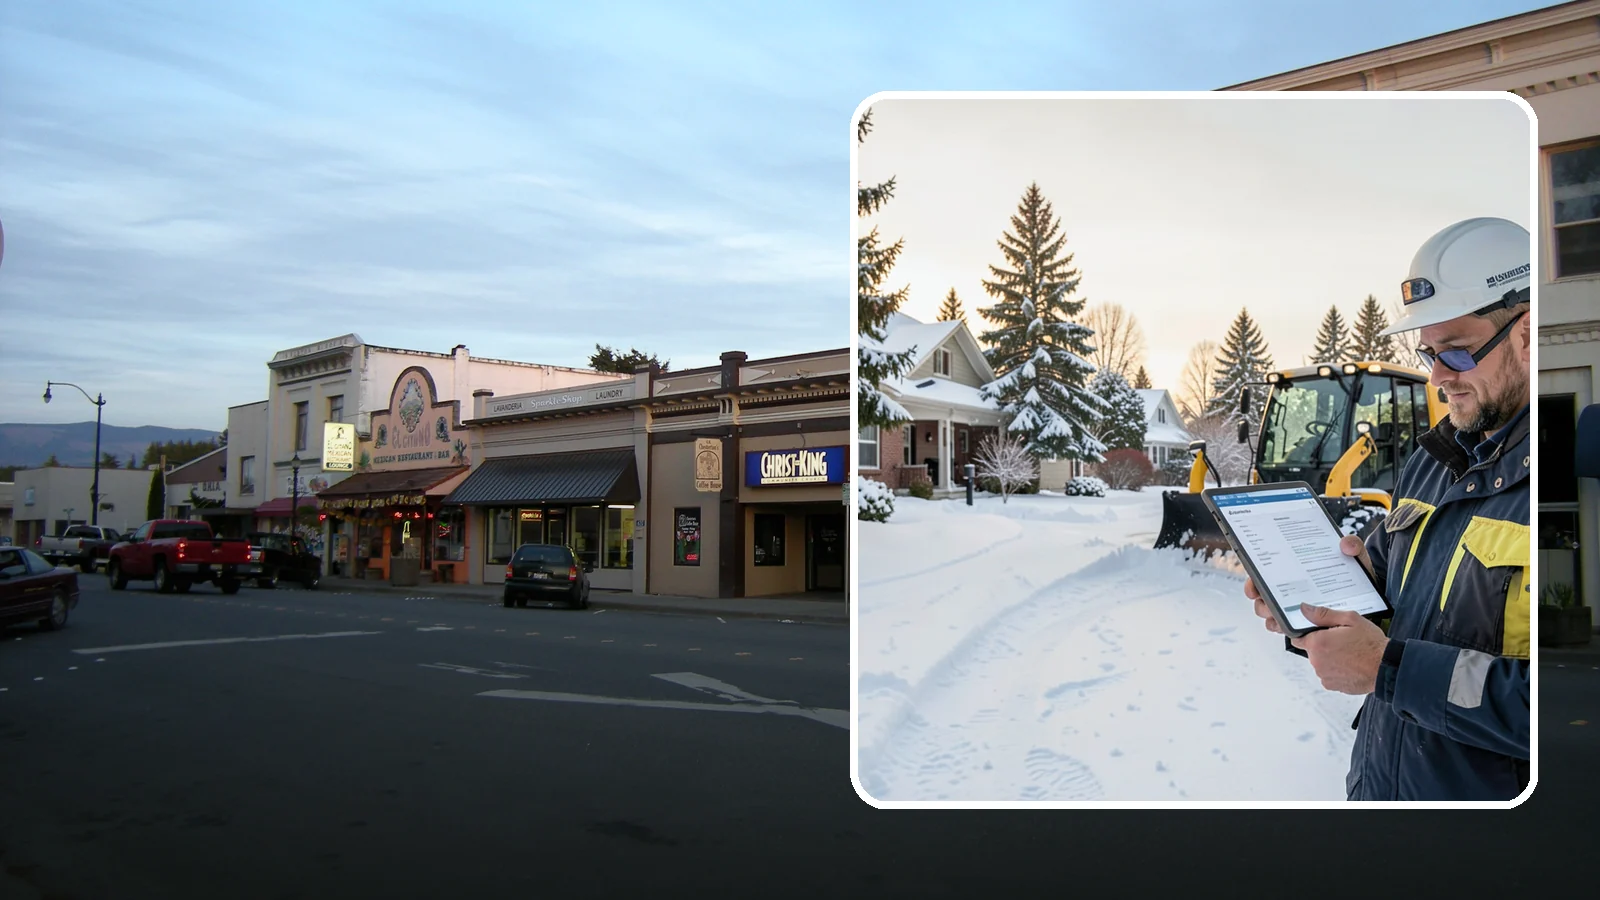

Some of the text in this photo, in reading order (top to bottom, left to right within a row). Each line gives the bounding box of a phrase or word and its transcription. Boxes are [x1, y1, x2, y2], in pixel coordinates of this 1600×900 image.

[595, 389, 623, 400] LAUNDRY
[493, 402, 522, 412] LAVANDERIA
[531, 395, 582, 408] Sparkle Shop
[392, 421, 431, 449] EL GITANO
[373, 455, 396, 464] MEXICAN
[397, 451, 434, 463] RESTAURANT
[437, 450, 450, 459] BAR
[761, 450, 827, 478] CHRIST KING
[697, 481, 722, 489] Coffee House
